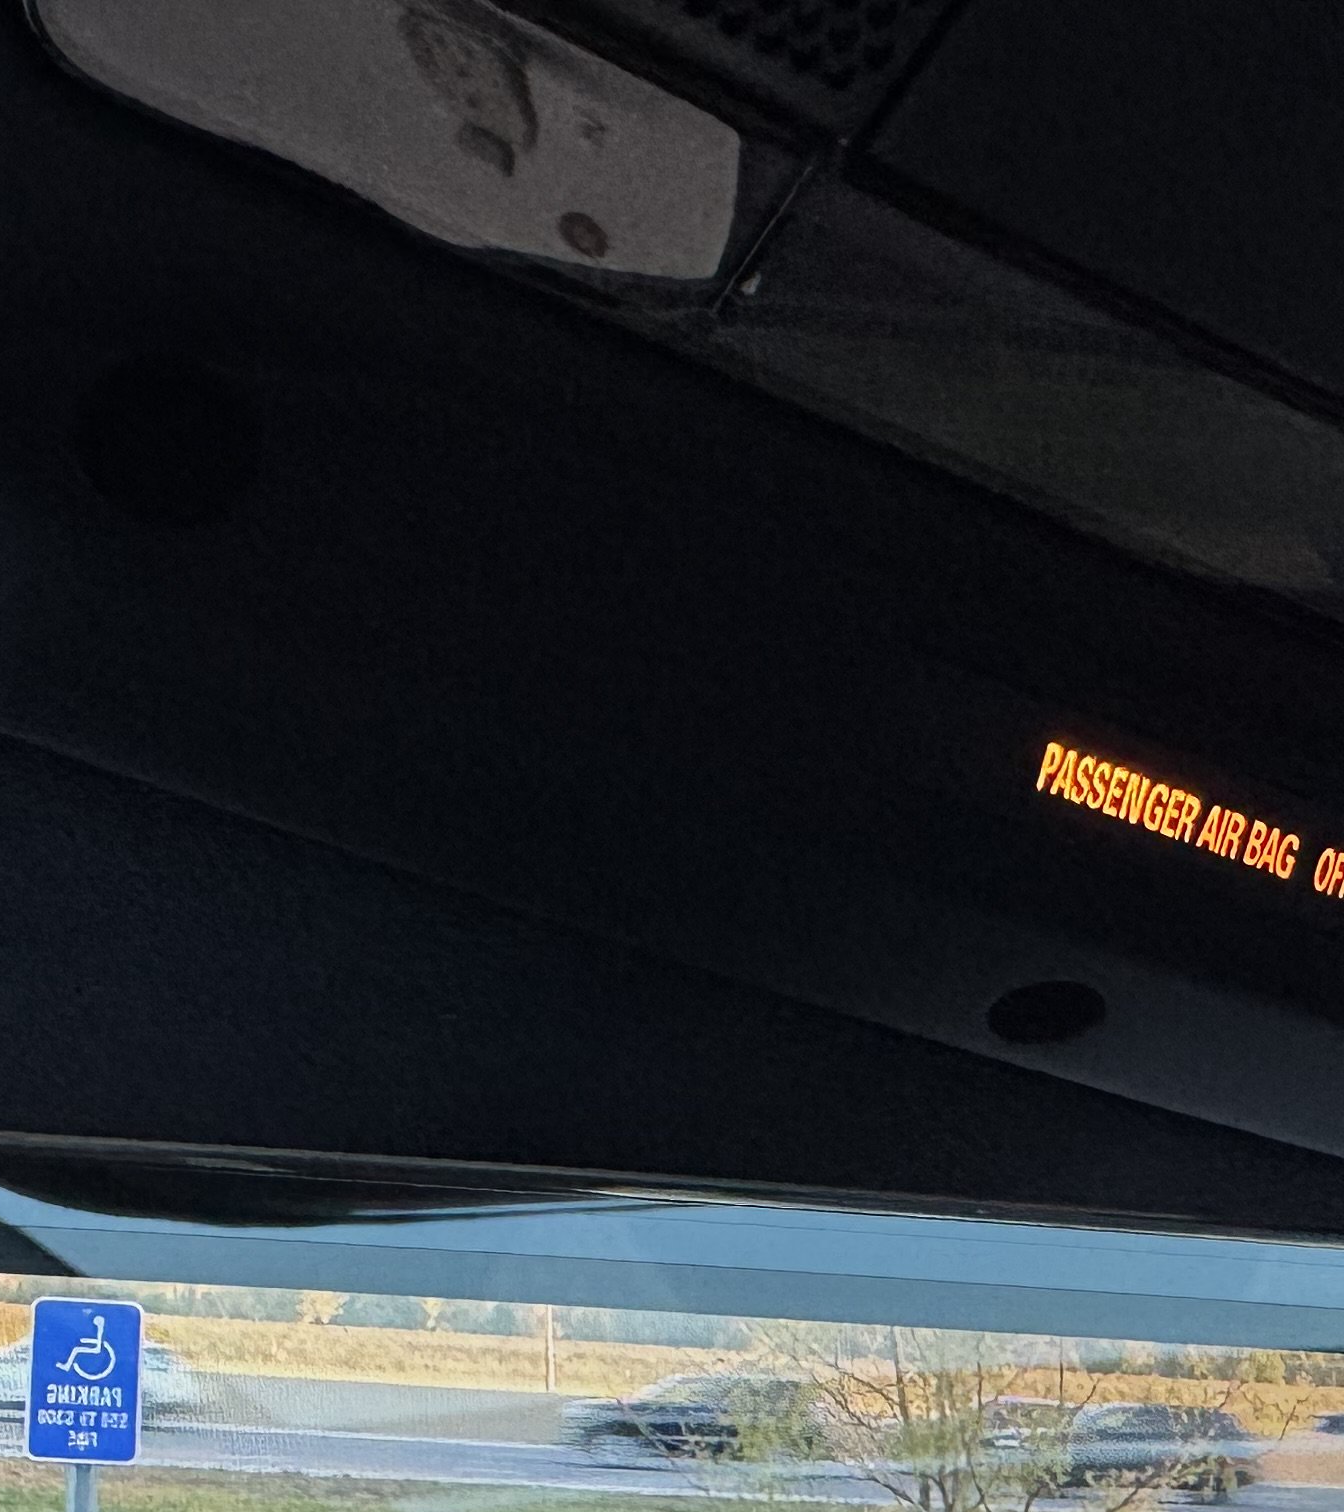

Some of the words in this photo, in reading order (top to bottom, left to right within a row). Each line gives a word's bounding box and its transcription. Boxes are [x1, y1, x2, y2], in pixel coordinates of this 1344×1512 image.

[1036, 741, 1202, 843] PASSENGER
[1196, 804, 1247, 860] AIR
[1243, 819, 1300, 880] BAG
